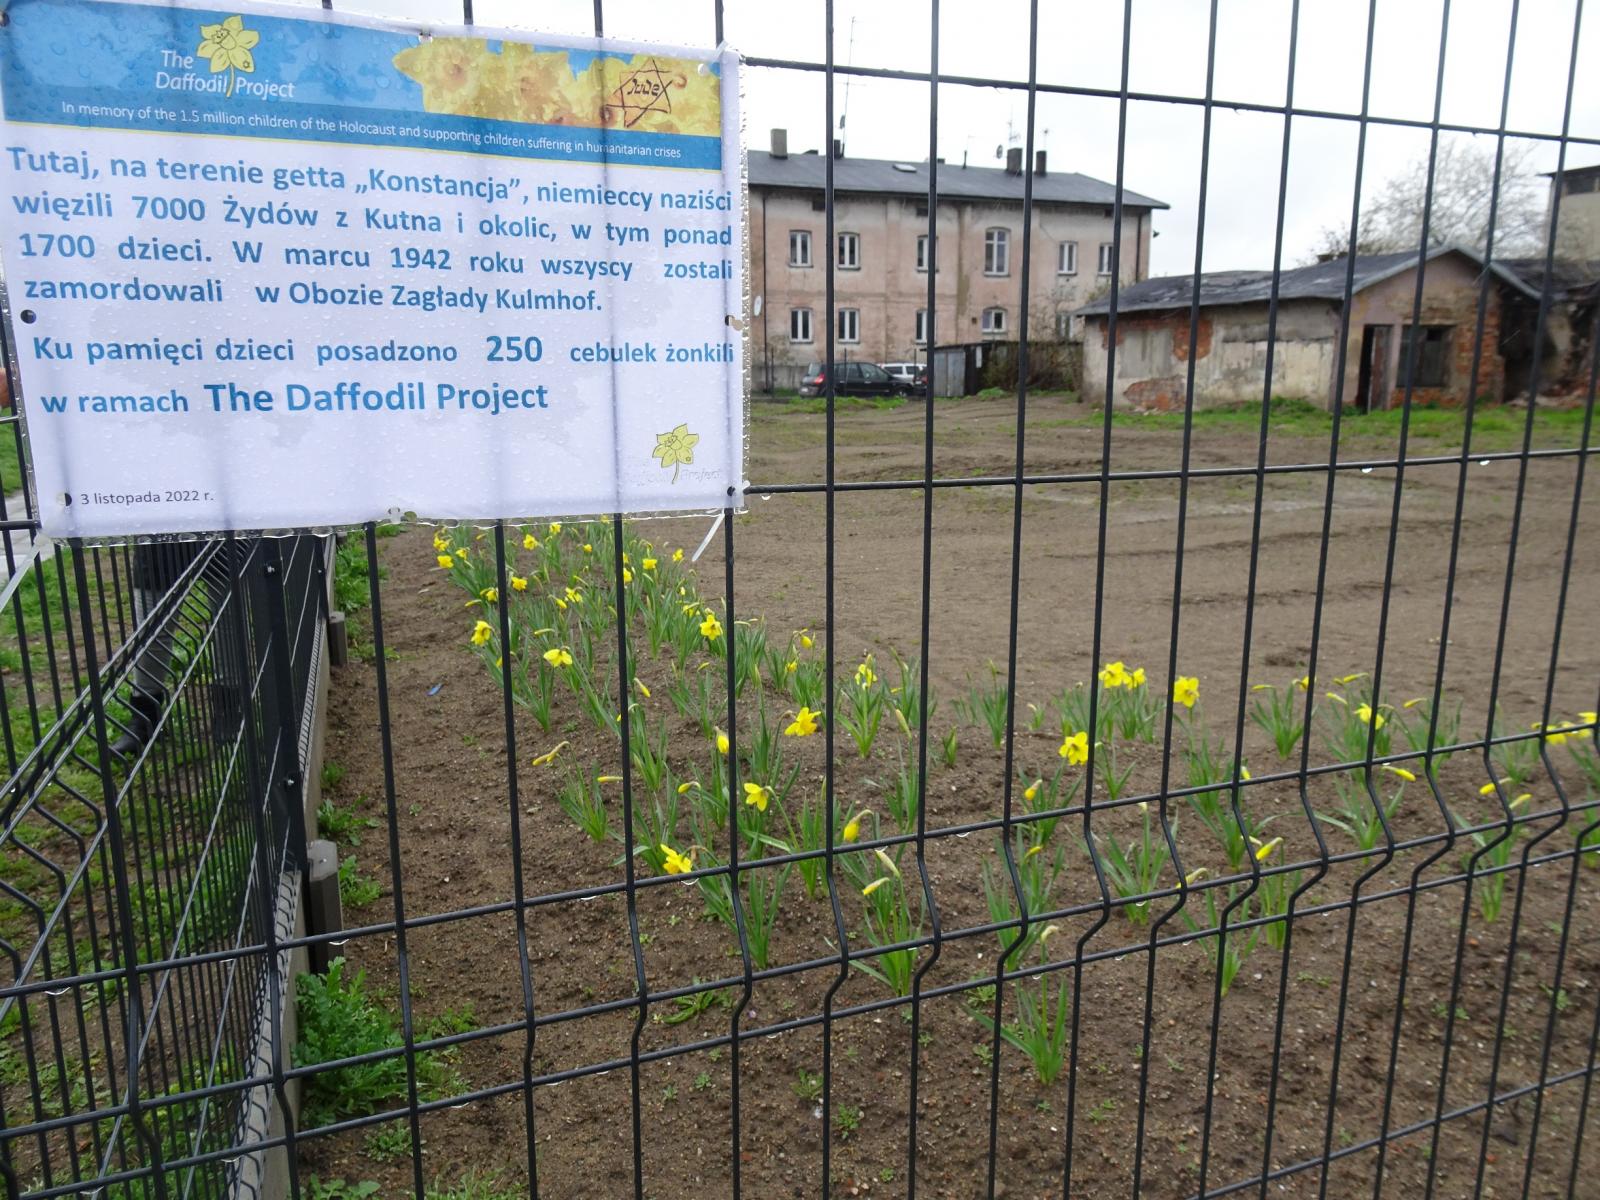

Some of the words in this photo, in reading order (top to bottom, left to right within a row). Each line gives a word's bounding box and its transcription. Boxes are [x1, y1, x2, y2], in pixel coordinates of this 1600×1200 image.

[161, 50, 194, 69] The
[156, 72, 228, 92] Daffodil
[235, 80, 295, 101] Project
[62, 101, 75, 113] In
[78, 105, 134, 121] memory
[138, 106, 151, 119] of
[154, 107, 177, 121] the
[180, 110, 199, 122] 1.5
[203, 111, 245, 125] million
[248, 113, 297, 128] children
[300, 116, 313, 130] of
[315, 118, 336, 131] the
[339, 120, 397, 136] Holocaust
[399, 125, 420, 138] and
[423, 127, 481, 145] supporting
[484, 132, 525, 147] children
[528, 136, 572, 153] suffering
[574, 140, 584, 152] in
[586, 140, 652, 157] humanitarian
[654, 146, 681, 158] crises
[7, 147, 99, 180] Tutaj,
[110, 158, 147, 178] na
[156, 157, 264, 183] terenie
[273, 167, 345, 191] getta
[355, 167, 529, 206] „Konstancja”,
[537, 183, 653, 212] niemieccy
[660, 189, 732, 211] naziści
[12, 191, 113, 221] więzili
[132, 196, 206, 222] 7000
[223, 195, 318, 229] Żydów
[335, 210, 348, 228] z
[365, 208, 441, 233] Kutna
[457, 213, 463, 233] i
[479, 214, 557, 242] okolic,
[571, 223, 591, 240] w
[606, 222, 650, 249] tym
[664, 225, 732, 248] ponad
[18, 233, 95, 258] 1700
[118, 237, 212, 262] dzieci.
[232, 241, 263, 264] W
[285, 248, 370, 267] marcu
[391, 248, 451, 270] 1942
[470, 251, 524, 274] roku
[541, 258, 632, 281] wszyscy
[664, 259, 732, 279] zostali
[24, 278, 223, 302] zamordowali
[255, 285, 280, 303] w
[289, 282, 383, 305] Obozie
[391, 285, 488, 313] Zagłady
[496, 288, 602, 311] Kulmhof.
[34, 337, 73, 360] Ku
[87, 338, 203, 365] pamięci
[216, 338, 294, 361] dzieci
[317, 340, 457, 365] posadzono
[486, 335, 542, 362] 250
[570, 342, 656, 363] cebulek
[666, 342, 734, 362] żonkili
[41, 394, 67, 413] w
[78, 390, 189, 413] ramach
[204, 383, 273, 411] The
[286, 382, 425, 411] Daffodil
[437, 383, 548, 415] Project
[81, 493, 89, 505] 3
[94, 491, 161, 506] listopada
[165, 490, 199, 502] 2022
[204, 491, 214, 502] r.
